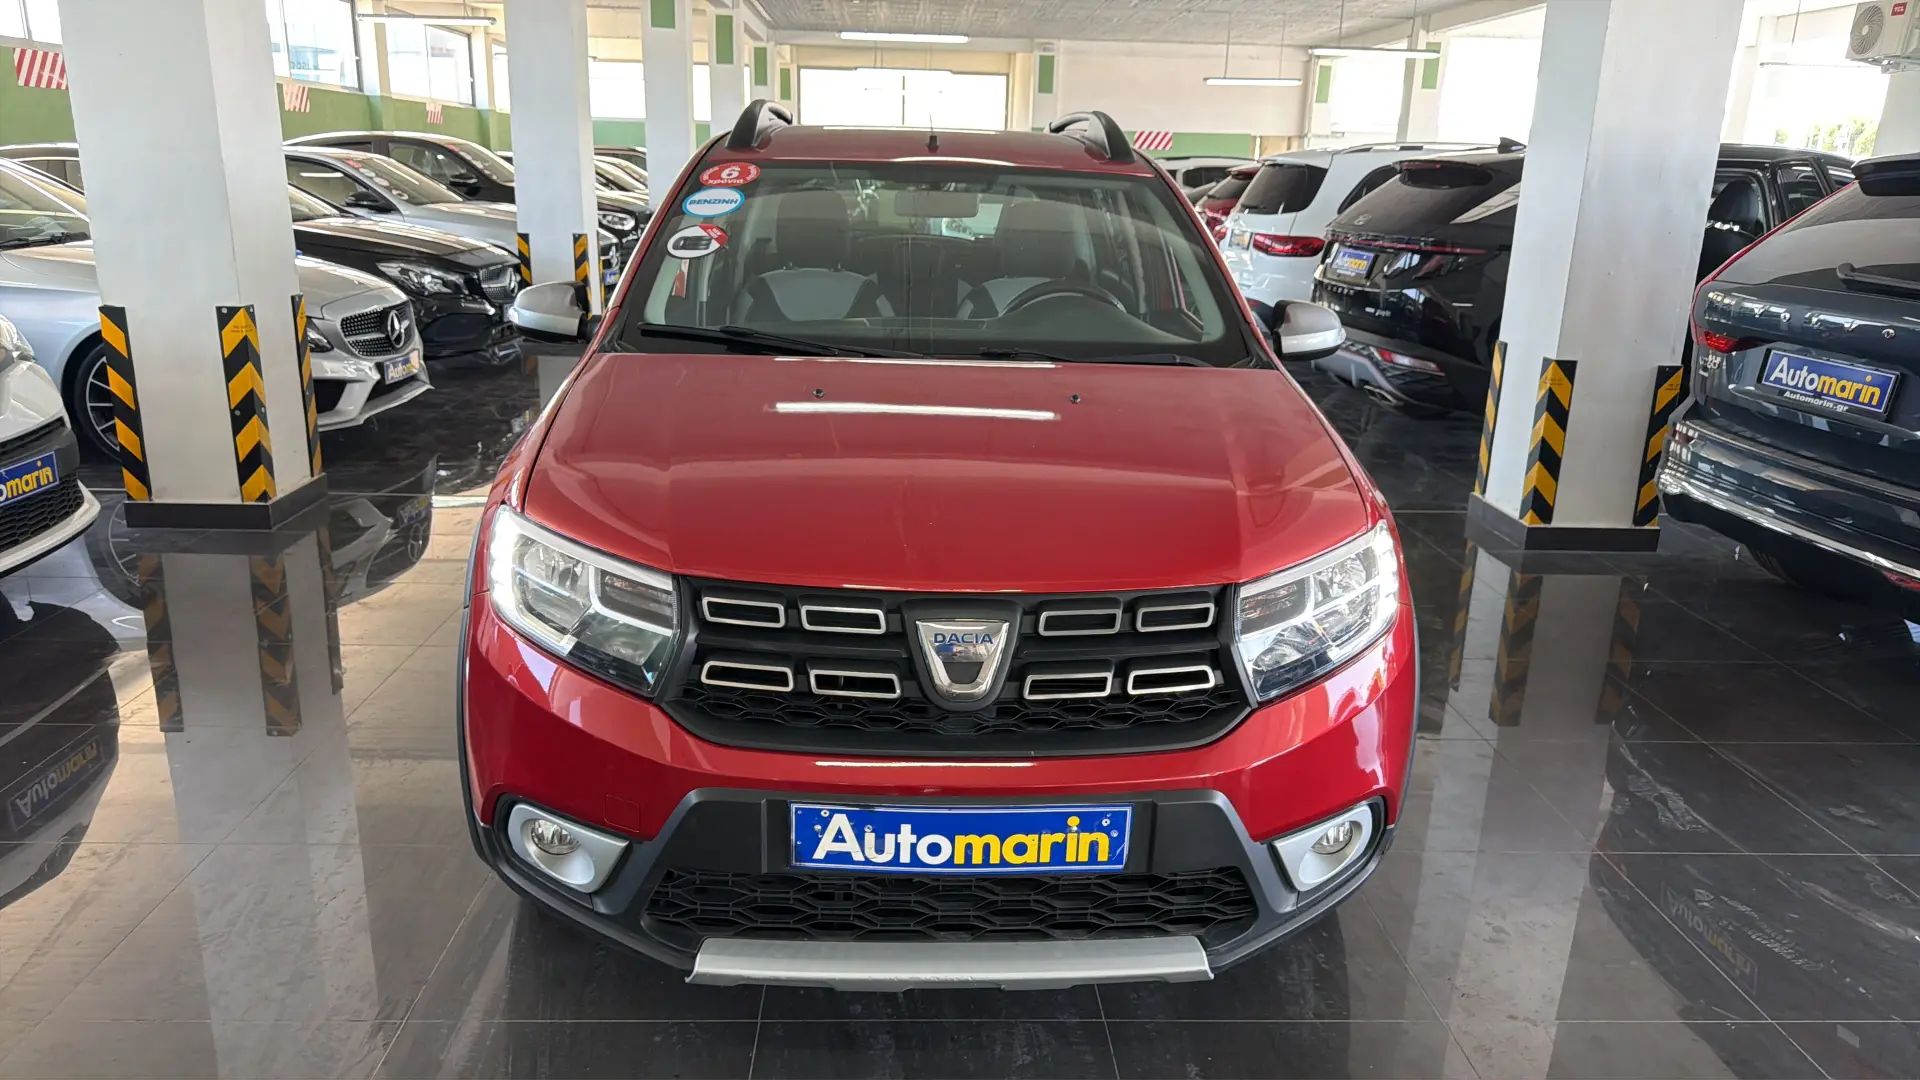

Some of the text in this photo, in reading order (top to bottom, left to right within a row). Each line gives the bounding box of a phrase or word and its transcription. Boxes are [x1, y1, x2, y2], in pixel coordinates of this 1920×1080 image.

[721, 167, 741, 179] 6
[1769, 356, 1881, 406] Automarin
[1784, 390, 1849, 412] Automarin.gr
[933, 632, 994, 645] DACIA
[811, 813, 1110, 865] Automarin
